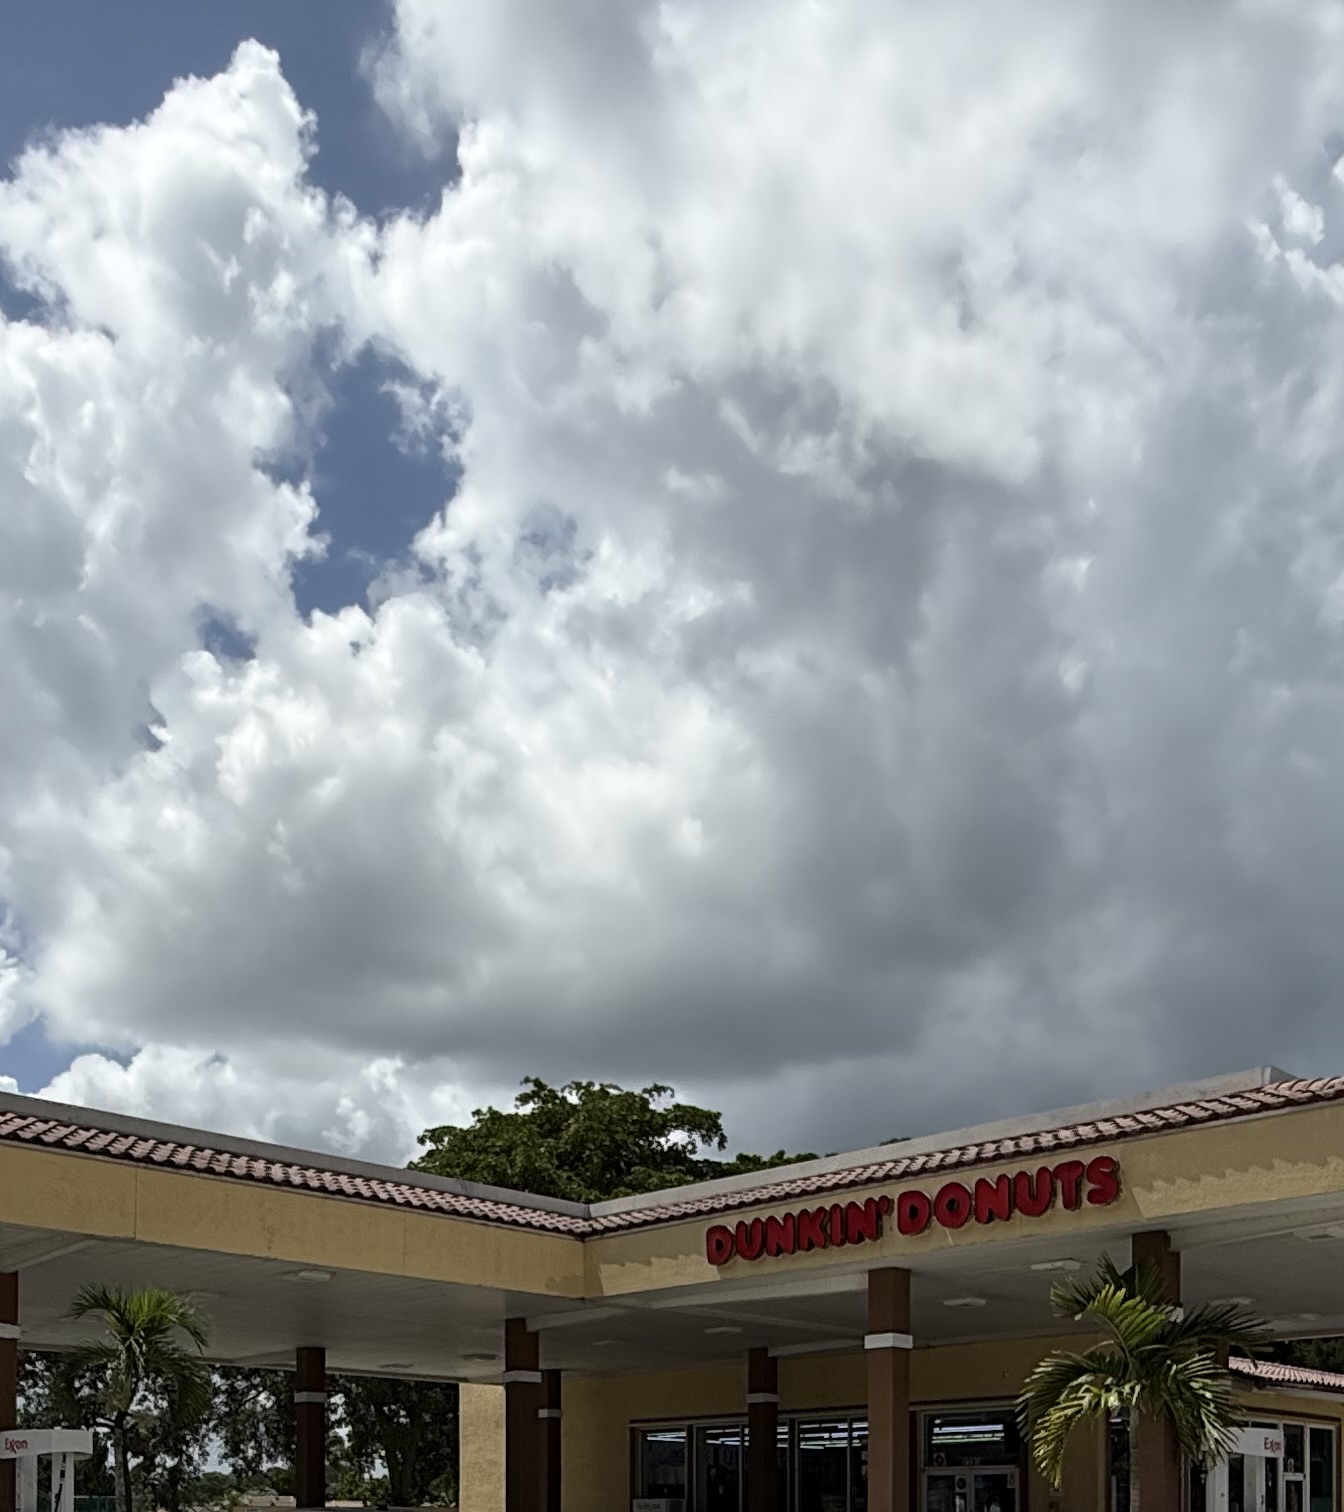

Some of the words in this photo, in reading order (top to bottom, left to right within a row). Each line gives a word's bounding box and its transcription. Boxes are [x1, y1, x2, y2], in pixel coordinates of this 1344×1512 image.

[706, 1194, 893, 1266] DUNKIN'
[897, 1156, 1120, 1236] DONUTS
[5, 1438, 28, 1454] Exxon
